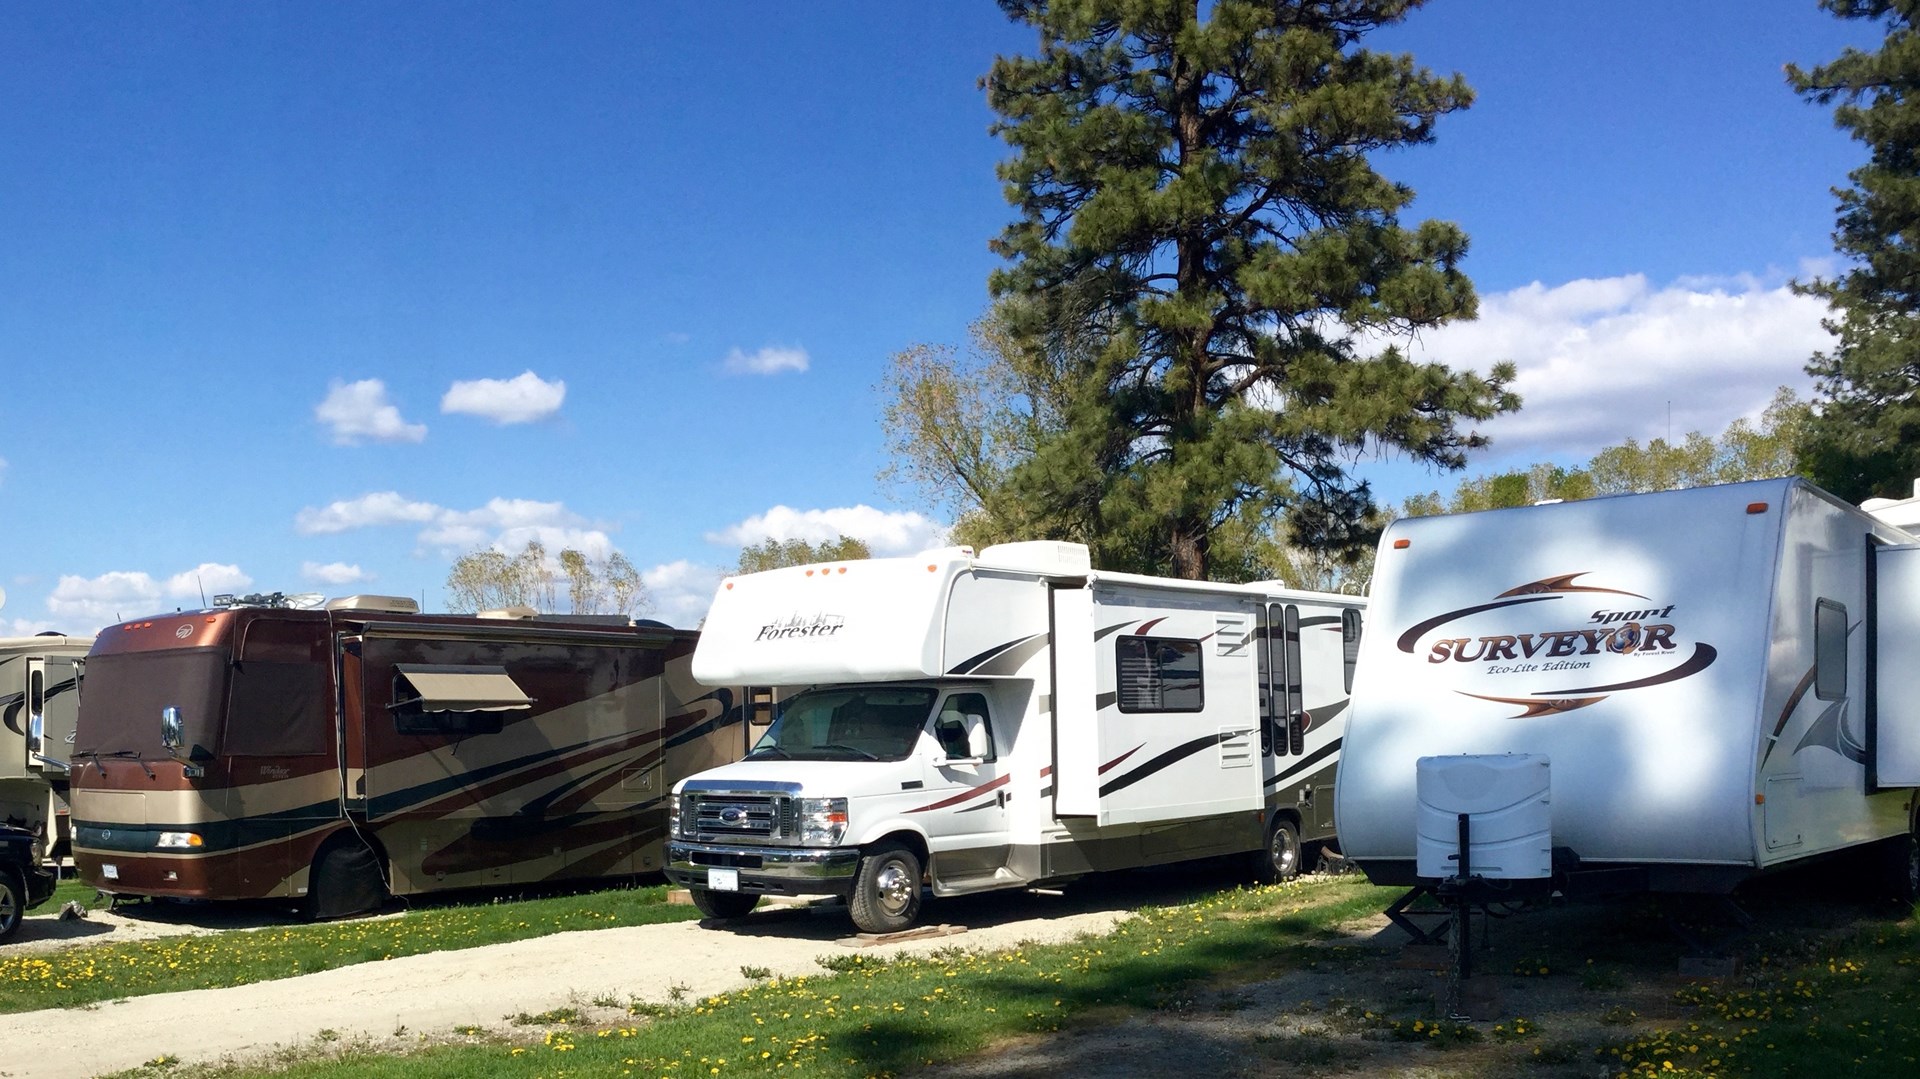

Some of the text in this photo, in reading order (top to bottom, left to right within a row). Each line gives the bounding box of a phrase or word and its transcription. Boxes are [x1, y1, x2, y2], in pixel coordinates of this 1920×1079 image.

[1587, 604, 1676, 625] Sport
[754, 624, 844, 642] Forester
[1428, 623, 1677, 664] SURVEYOR
[1487, 660, 1591, 675] Eco-Lite Edition
